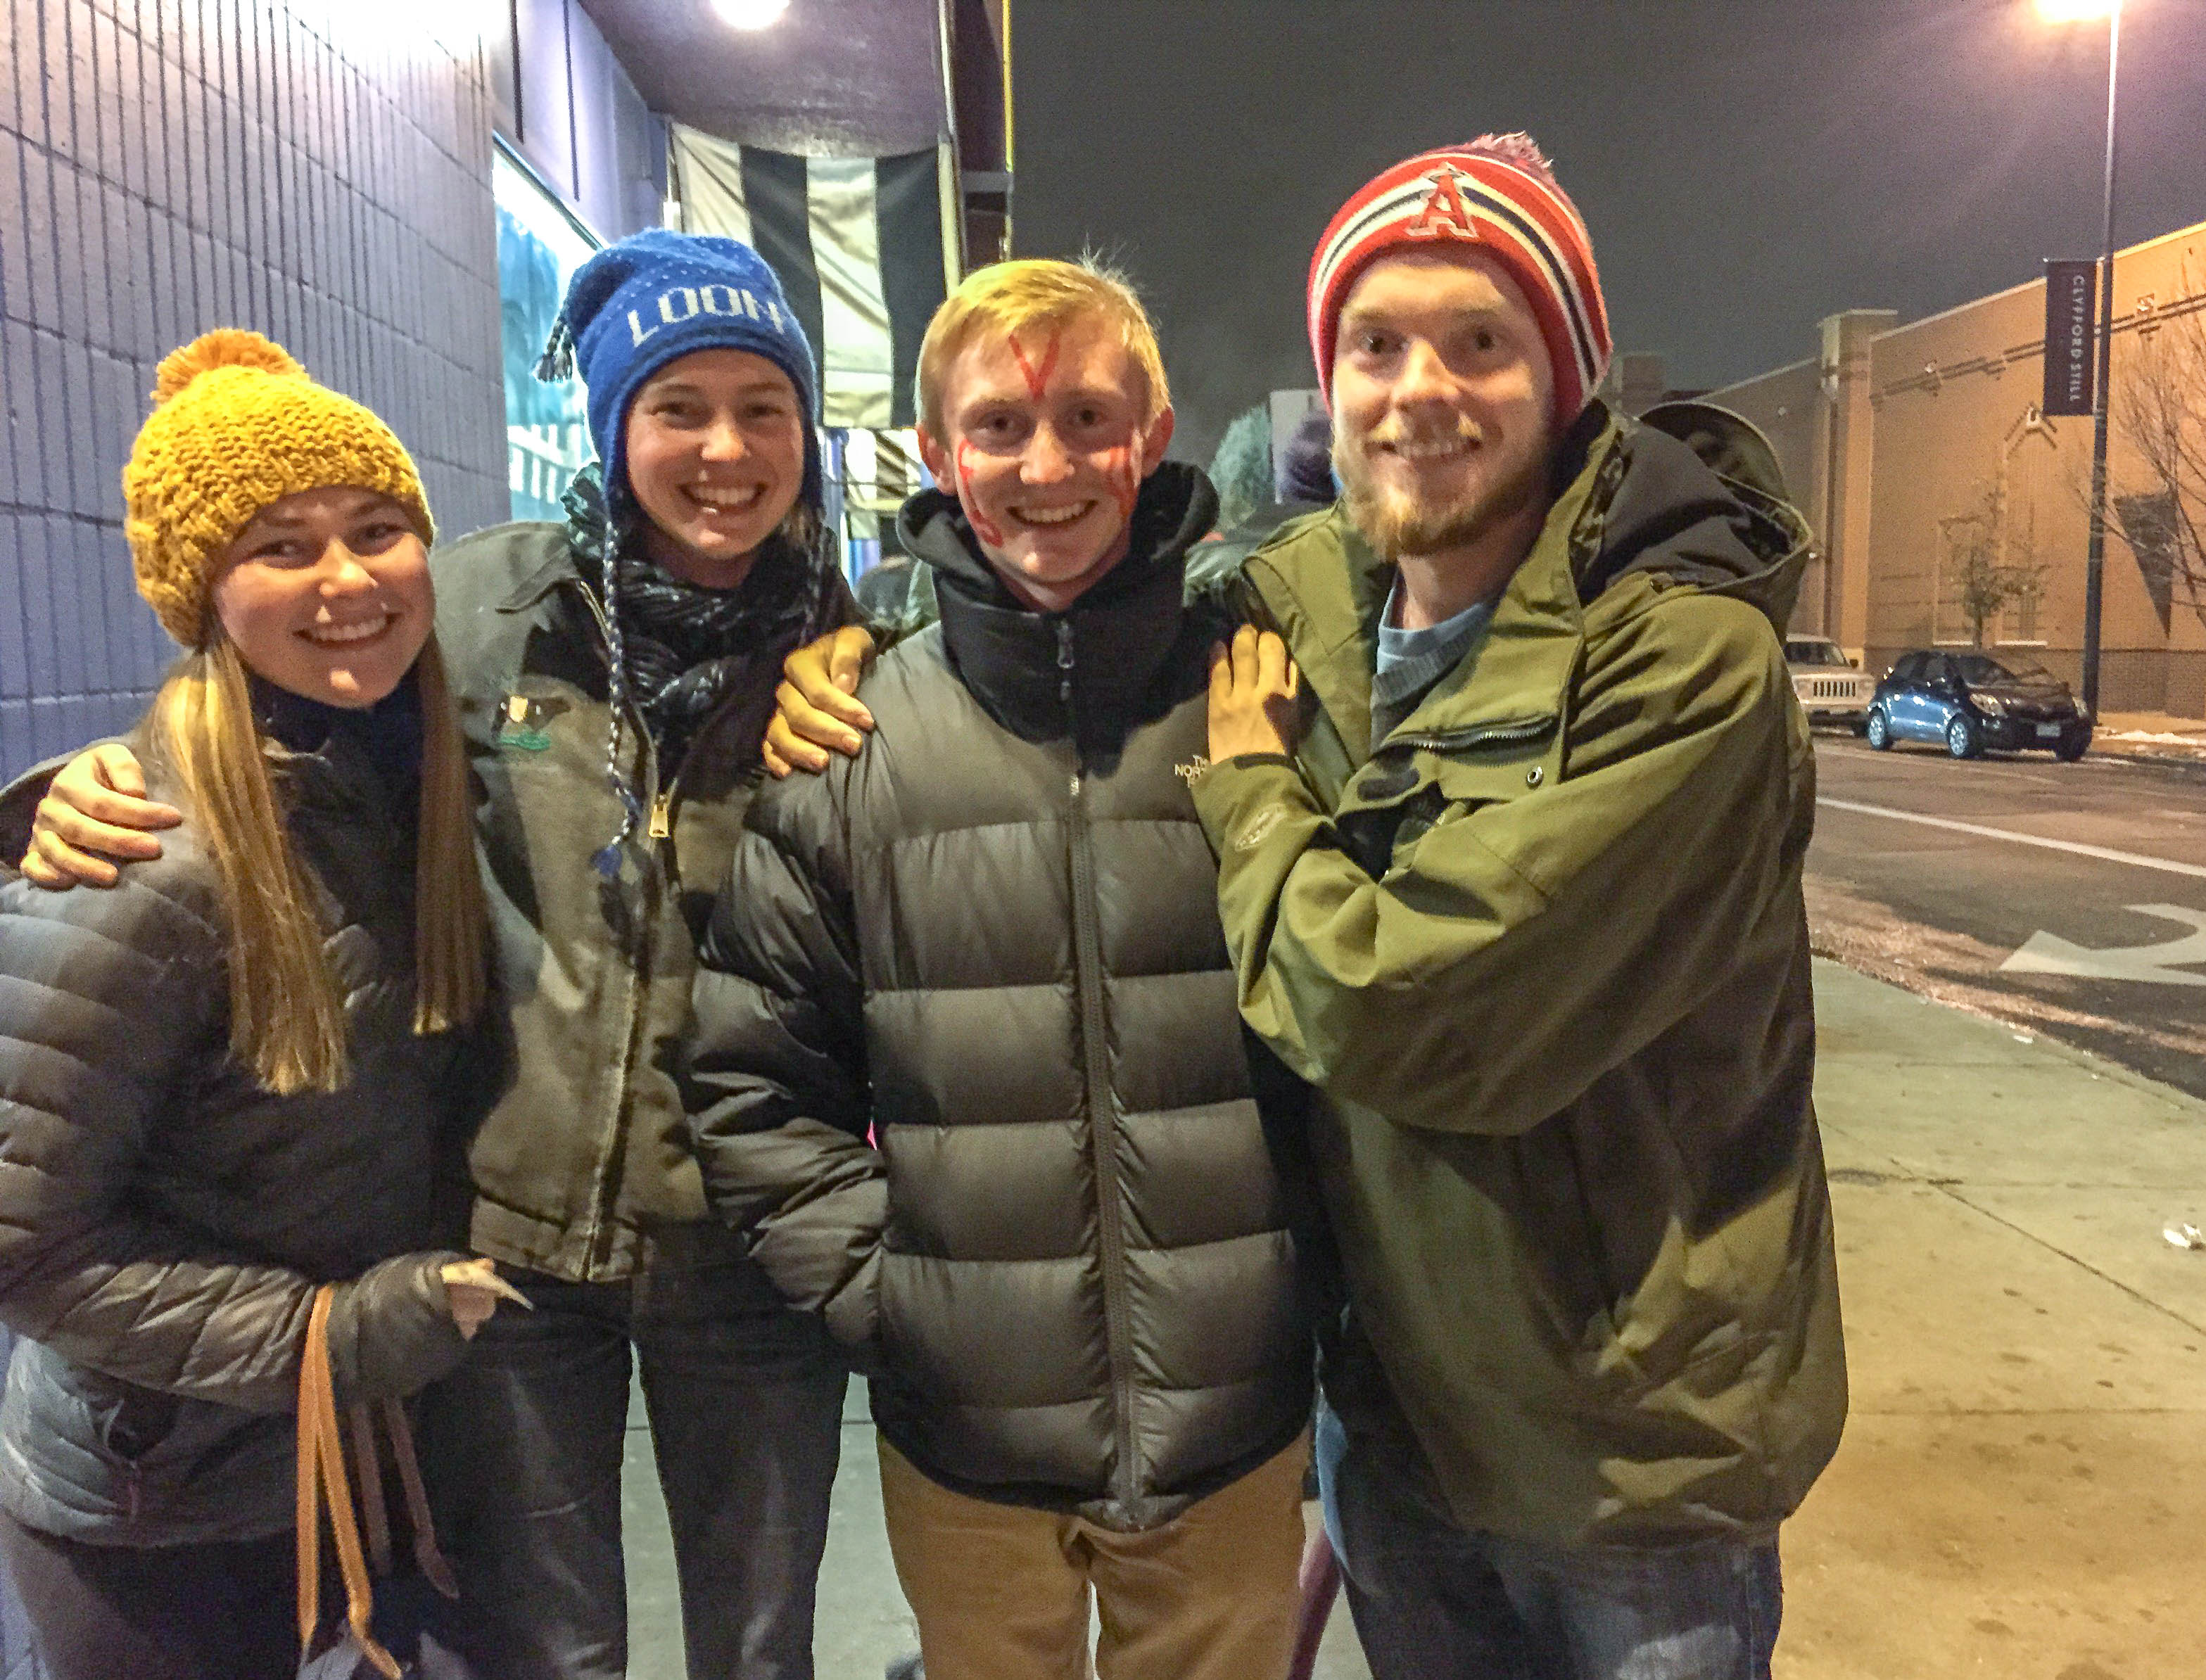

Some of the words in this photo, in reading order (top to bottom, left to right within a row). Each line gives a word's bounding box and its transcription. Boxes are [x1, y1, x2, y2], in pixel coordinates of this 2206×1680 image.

[1405, 160, 1479, 238] A
[626, 284, 785, 348] LOON
[2070, 275, 2085, 359] CLYFFORD
